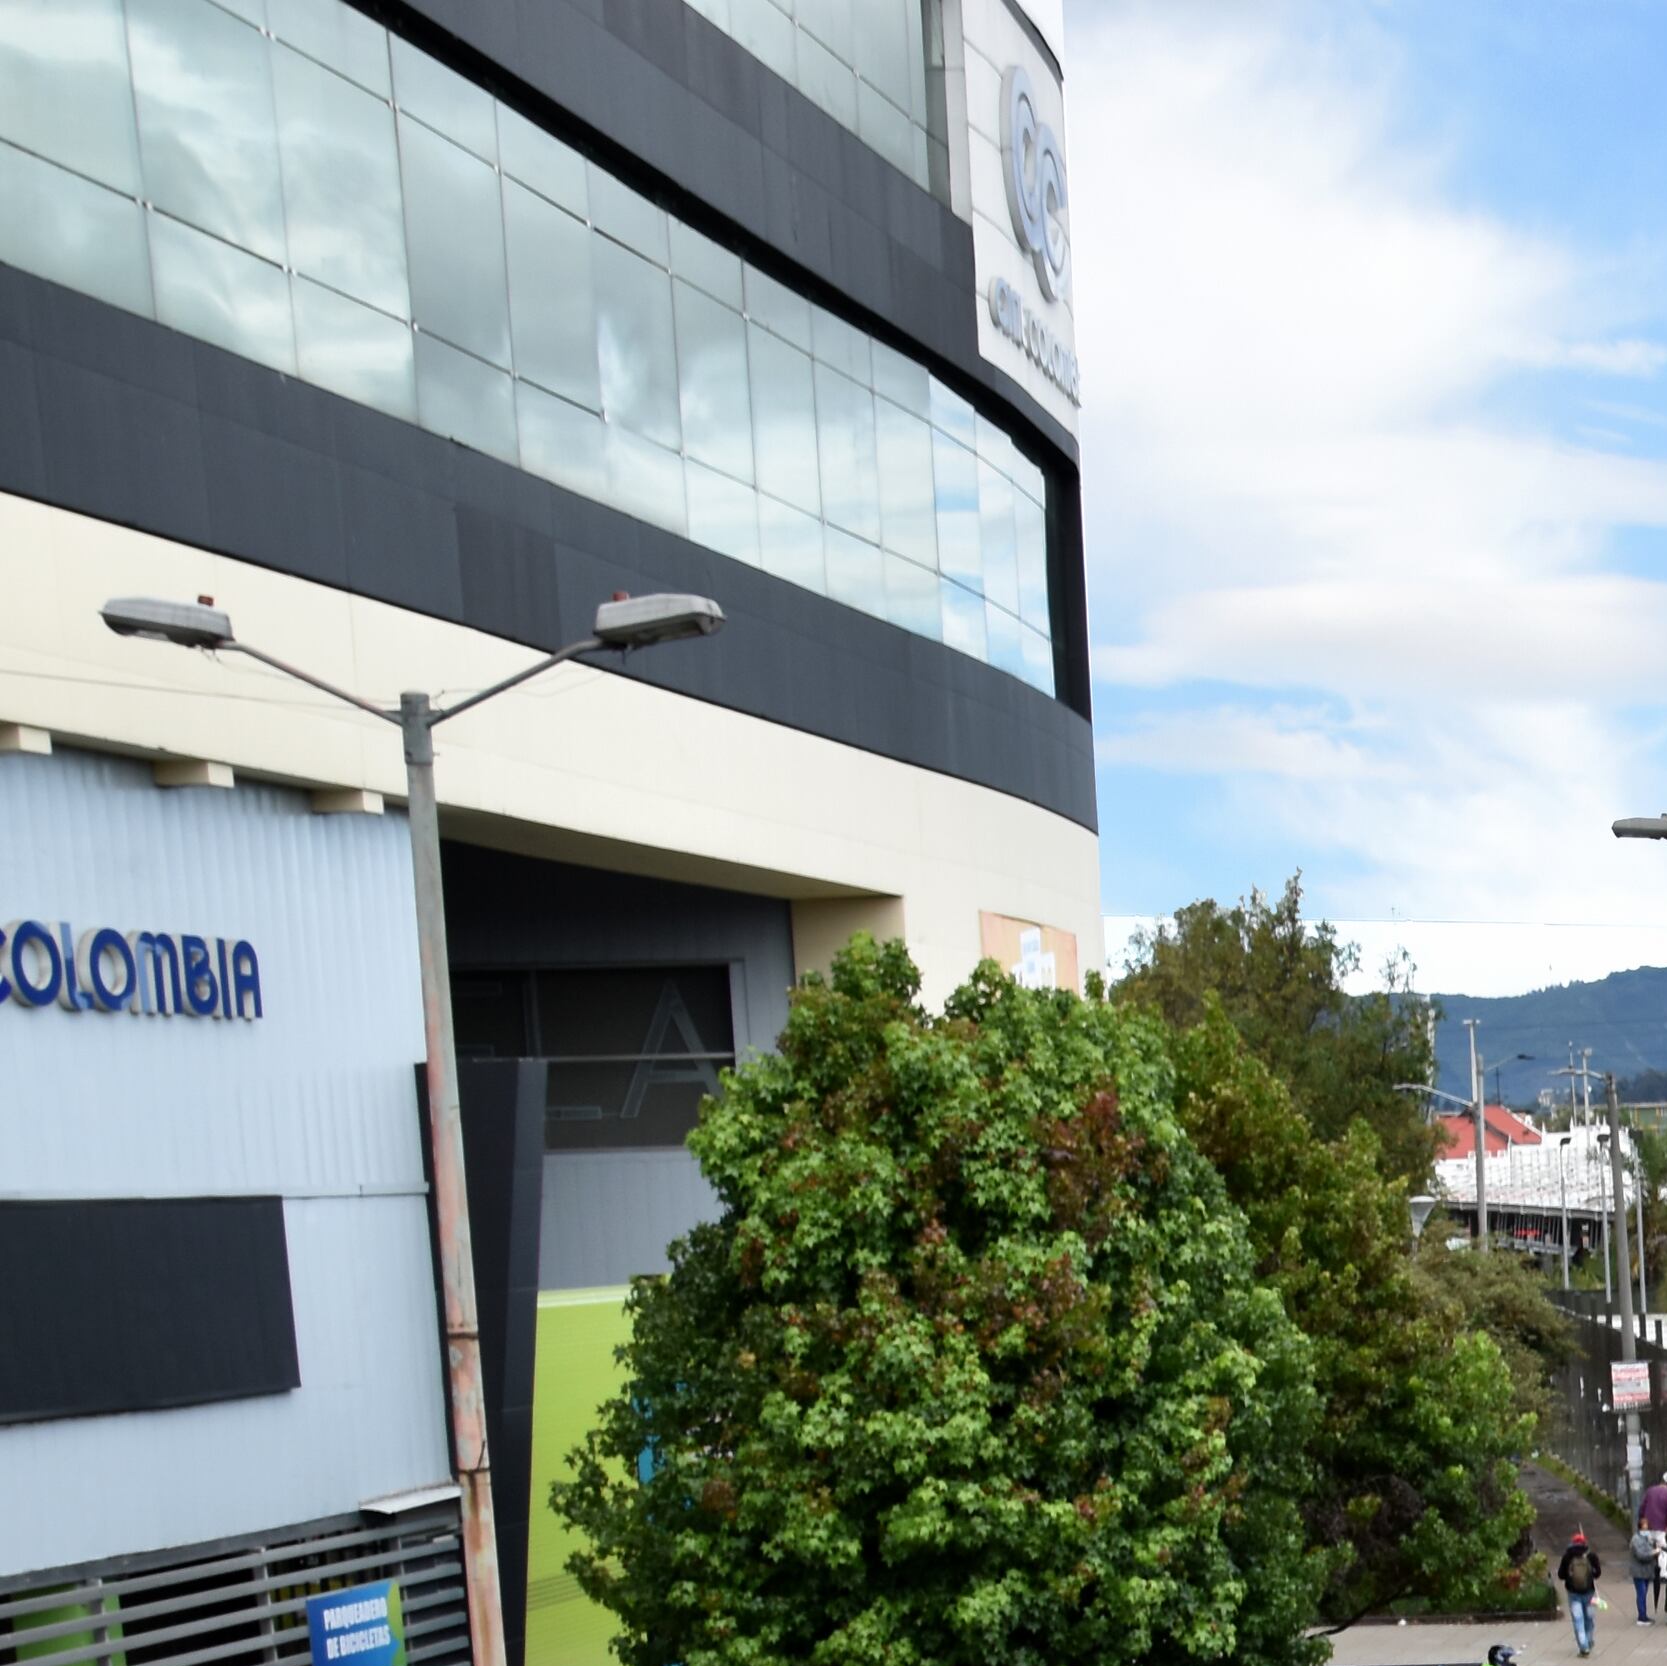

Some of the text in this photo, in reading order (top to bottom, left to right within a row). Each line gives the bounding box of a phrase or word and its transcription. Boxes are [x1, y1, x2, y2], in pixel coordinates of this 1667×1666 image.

[0, 920, 262, 1020] OLOMBIA
[323, 1597, 388, 1631] PARQUEADERO
[326, 1624, 391, 1660] DE BICICLETAS
